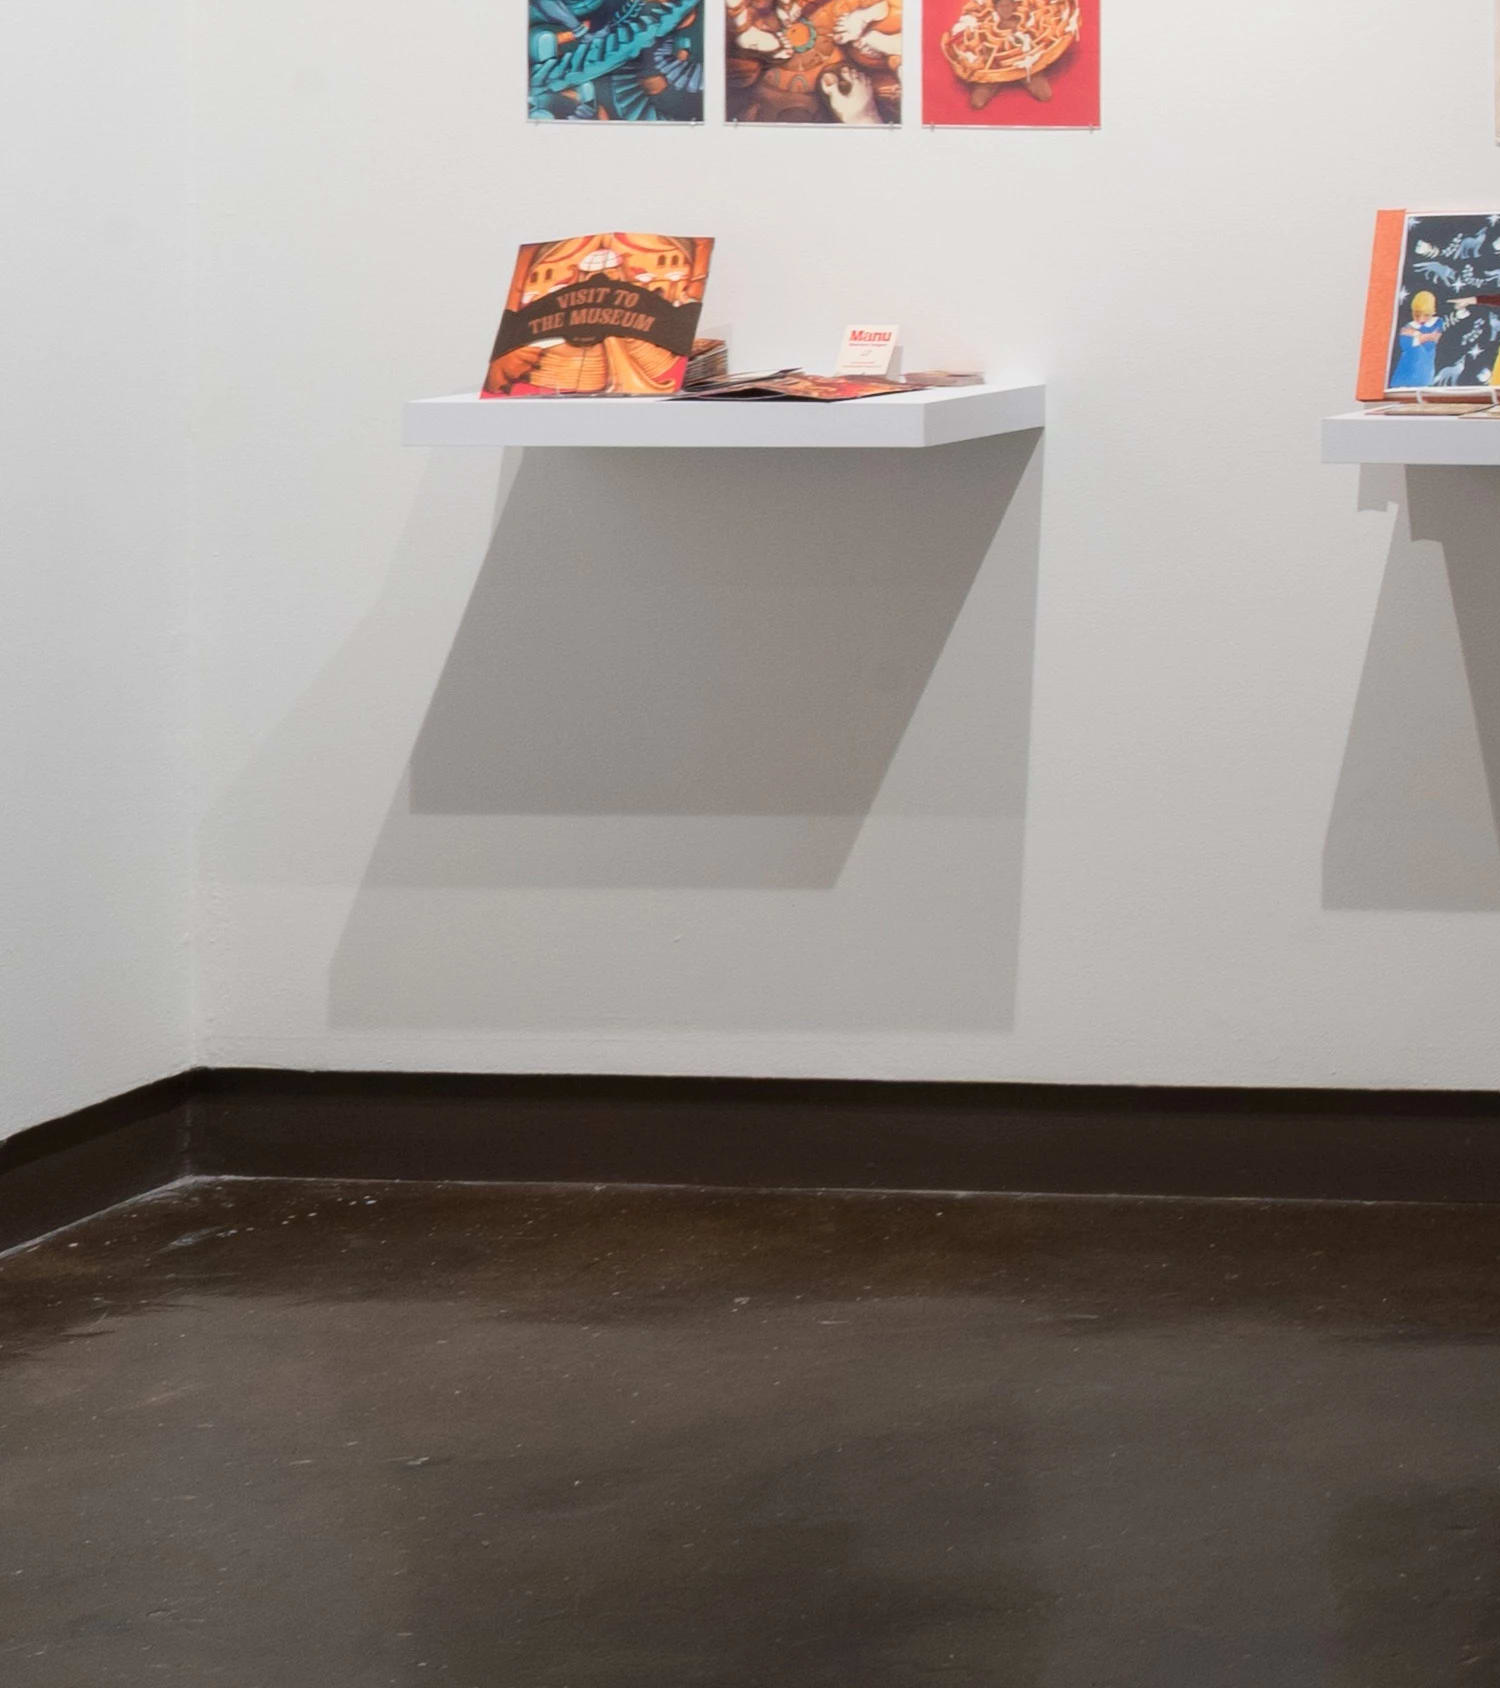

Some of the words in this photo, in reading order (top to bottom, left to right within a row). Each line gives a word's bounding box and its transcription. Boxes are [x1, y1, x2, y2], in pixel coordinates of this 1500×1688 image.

[556, 287, 612, 309] VISIT
[613, 289, 640, 308] TO
[527, 312, 565, 335] THE
[568, 307, 656, 332] MUSEUM
[849, 330, 892, 342] Manu
